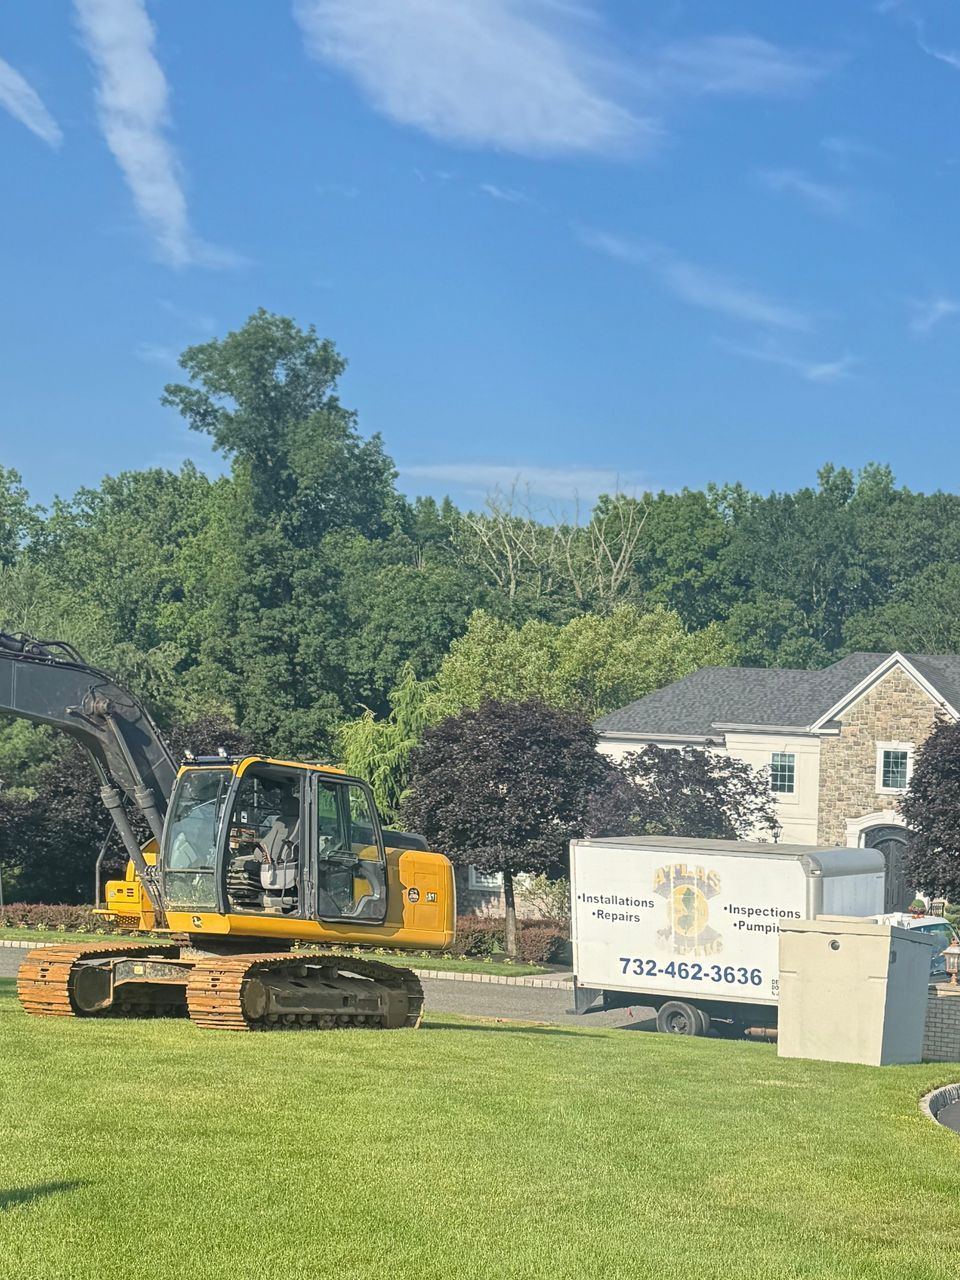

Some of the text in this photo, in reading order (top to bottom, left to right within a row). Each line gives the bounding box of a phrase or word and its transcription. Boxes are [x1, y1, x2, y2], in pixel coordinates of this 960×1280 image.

[653, 864, 721, 894] ATLAS
[738, 920, 780, 935] Pumpi
[619, 957, 763, 986] 732-462-3636
